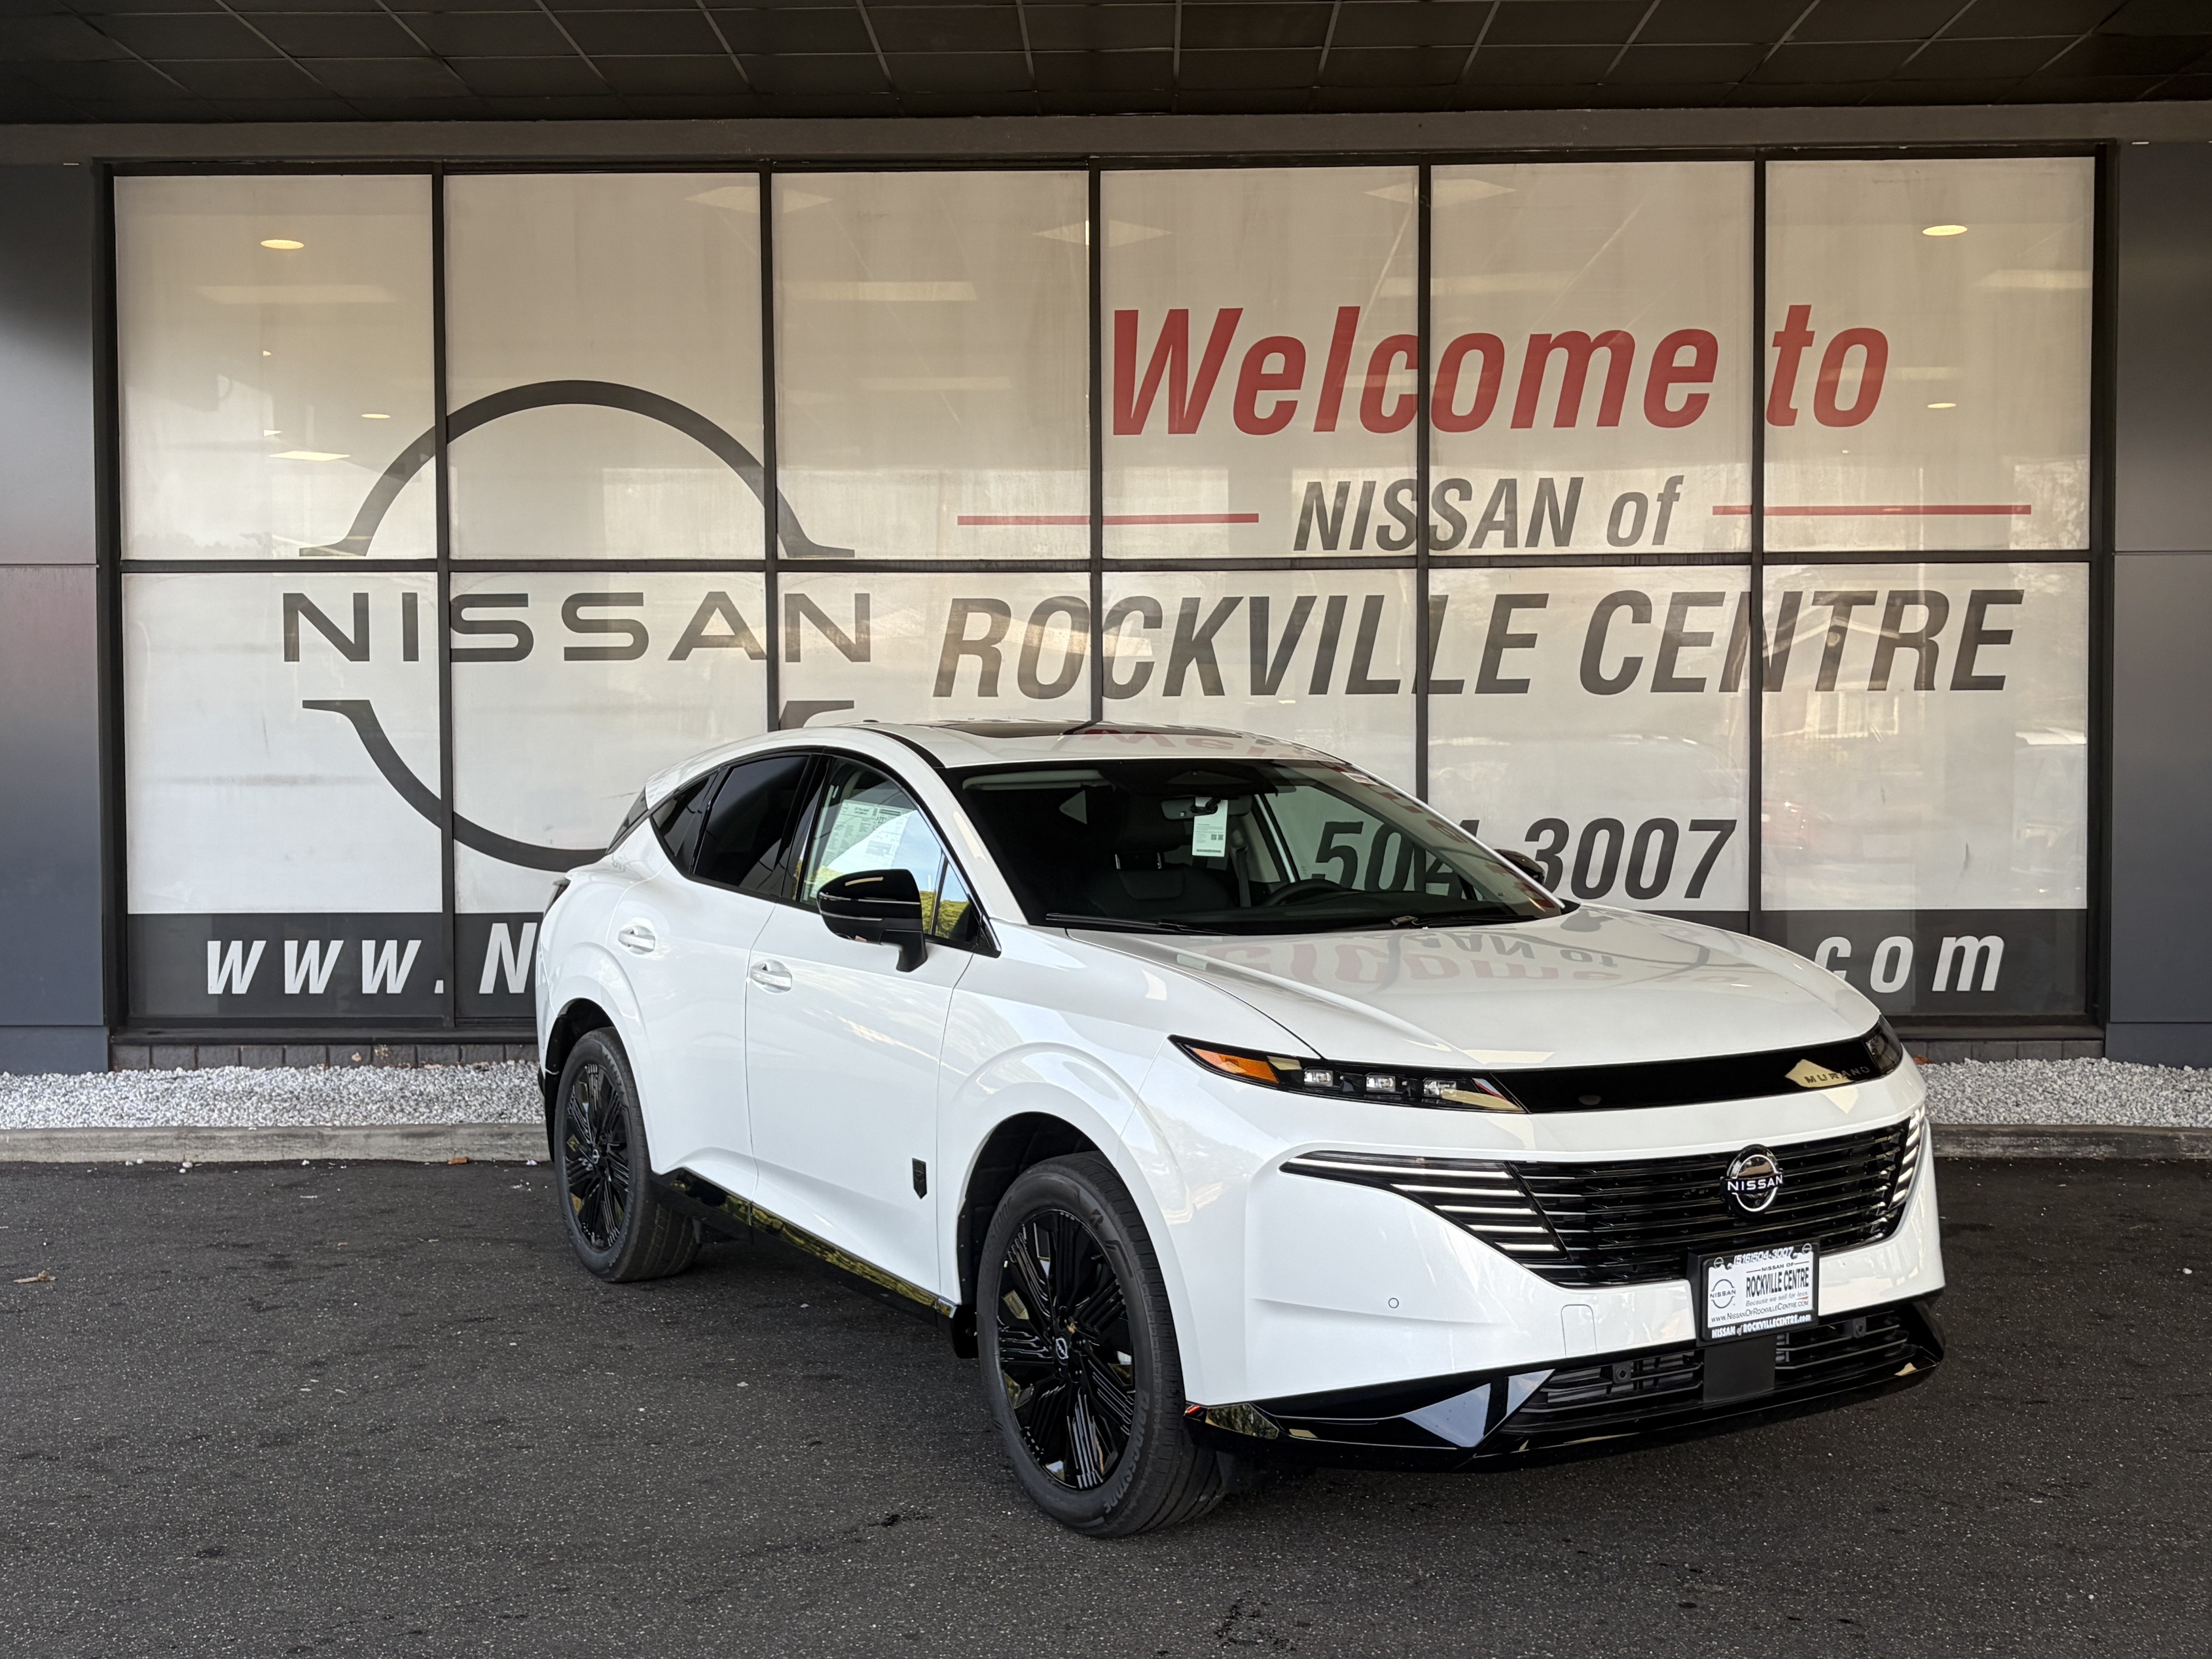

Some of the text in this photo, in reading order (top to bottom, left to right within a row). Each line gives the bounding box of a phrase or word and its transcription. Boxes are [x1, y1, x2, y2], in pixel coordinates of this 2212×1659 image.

[1113, 304, 1889, 435] Welcome to
[1293, 475, 1684, 551] NISSAN of
[283, 592, 871, 662] NISSAN
[933, 588, 2023, 701] ROCKVILLE CENTRE
[1804, 1066, 1870, 1083] MURANO
[1728, 1174, 1783, 1191] NISSAN
[1710, 1290, 1736, 1298] NISSAN
[1746, 1267, 1809, 1298] ROCKVILLE CENTRE
[1712, 1326, 1736, 1339] NISSAN
